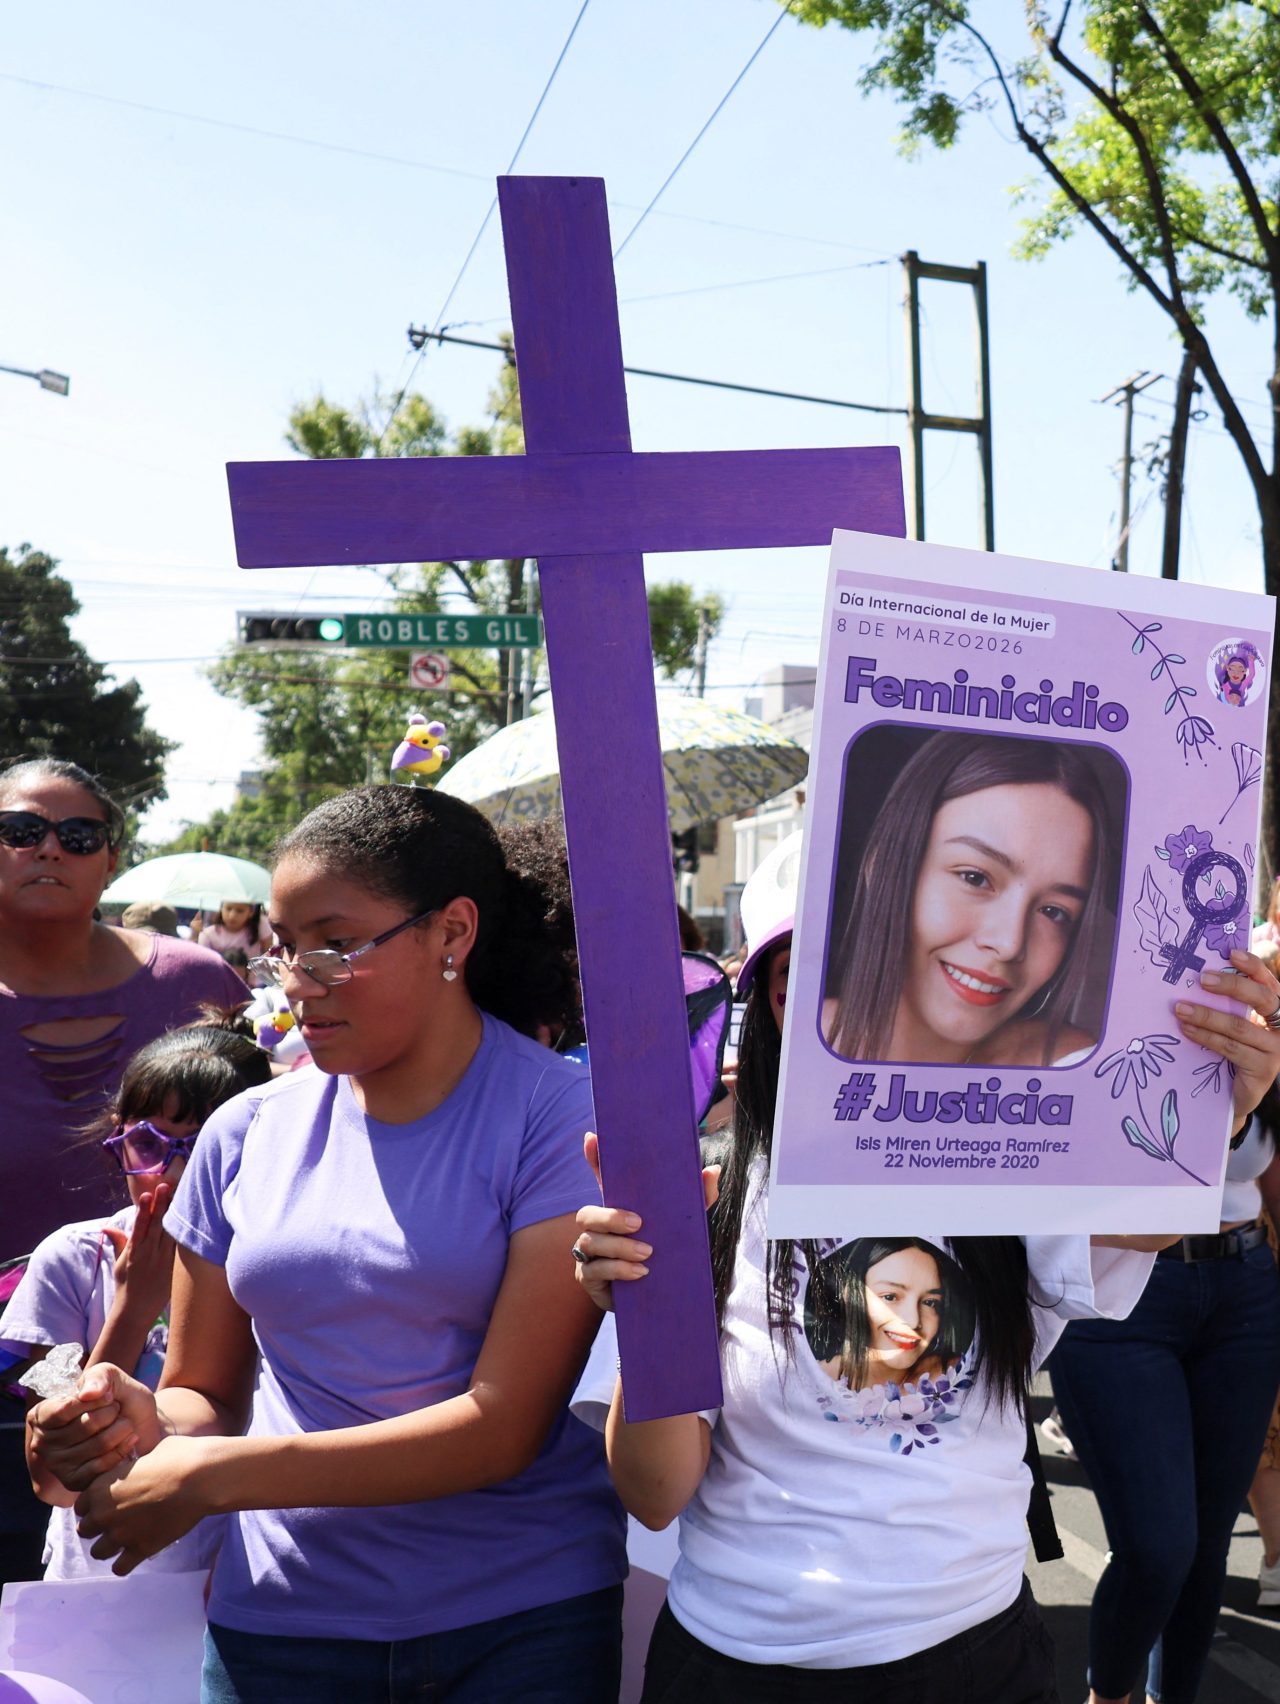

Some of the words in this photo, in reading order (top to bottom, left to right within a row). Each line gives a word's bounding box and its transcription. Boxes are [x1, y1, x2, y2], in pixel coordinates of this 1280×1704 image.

[358, 619, 469, 642] ROBLES
[486, 621, 528, 642] GIL
[840, 592, 864, 607] Día
[869, 595, 967, 621] Internacional
[970, 610, 989, 624] de
[993, 612, 1006, 626] la
[1010, 615, 1051, 632] Mujer
[837, 618, 847, 633] 8
[858, 620, 885, 637] DE
[896, 625, 1023, 655] MARZO2026
[844, 655, 1129, 733] Feminicidio
[833, 1073, 1074, 1126] #Justicia
[884, 1153, 904, 1168] 22
[908, 1154, 997, 1169] Noviembre
[1000, 1154, 1040, 1169] 2020
[936, 1136, 1001, 1155] Urteaga
[1006, 1137, 1071, 1153] Ramírez
